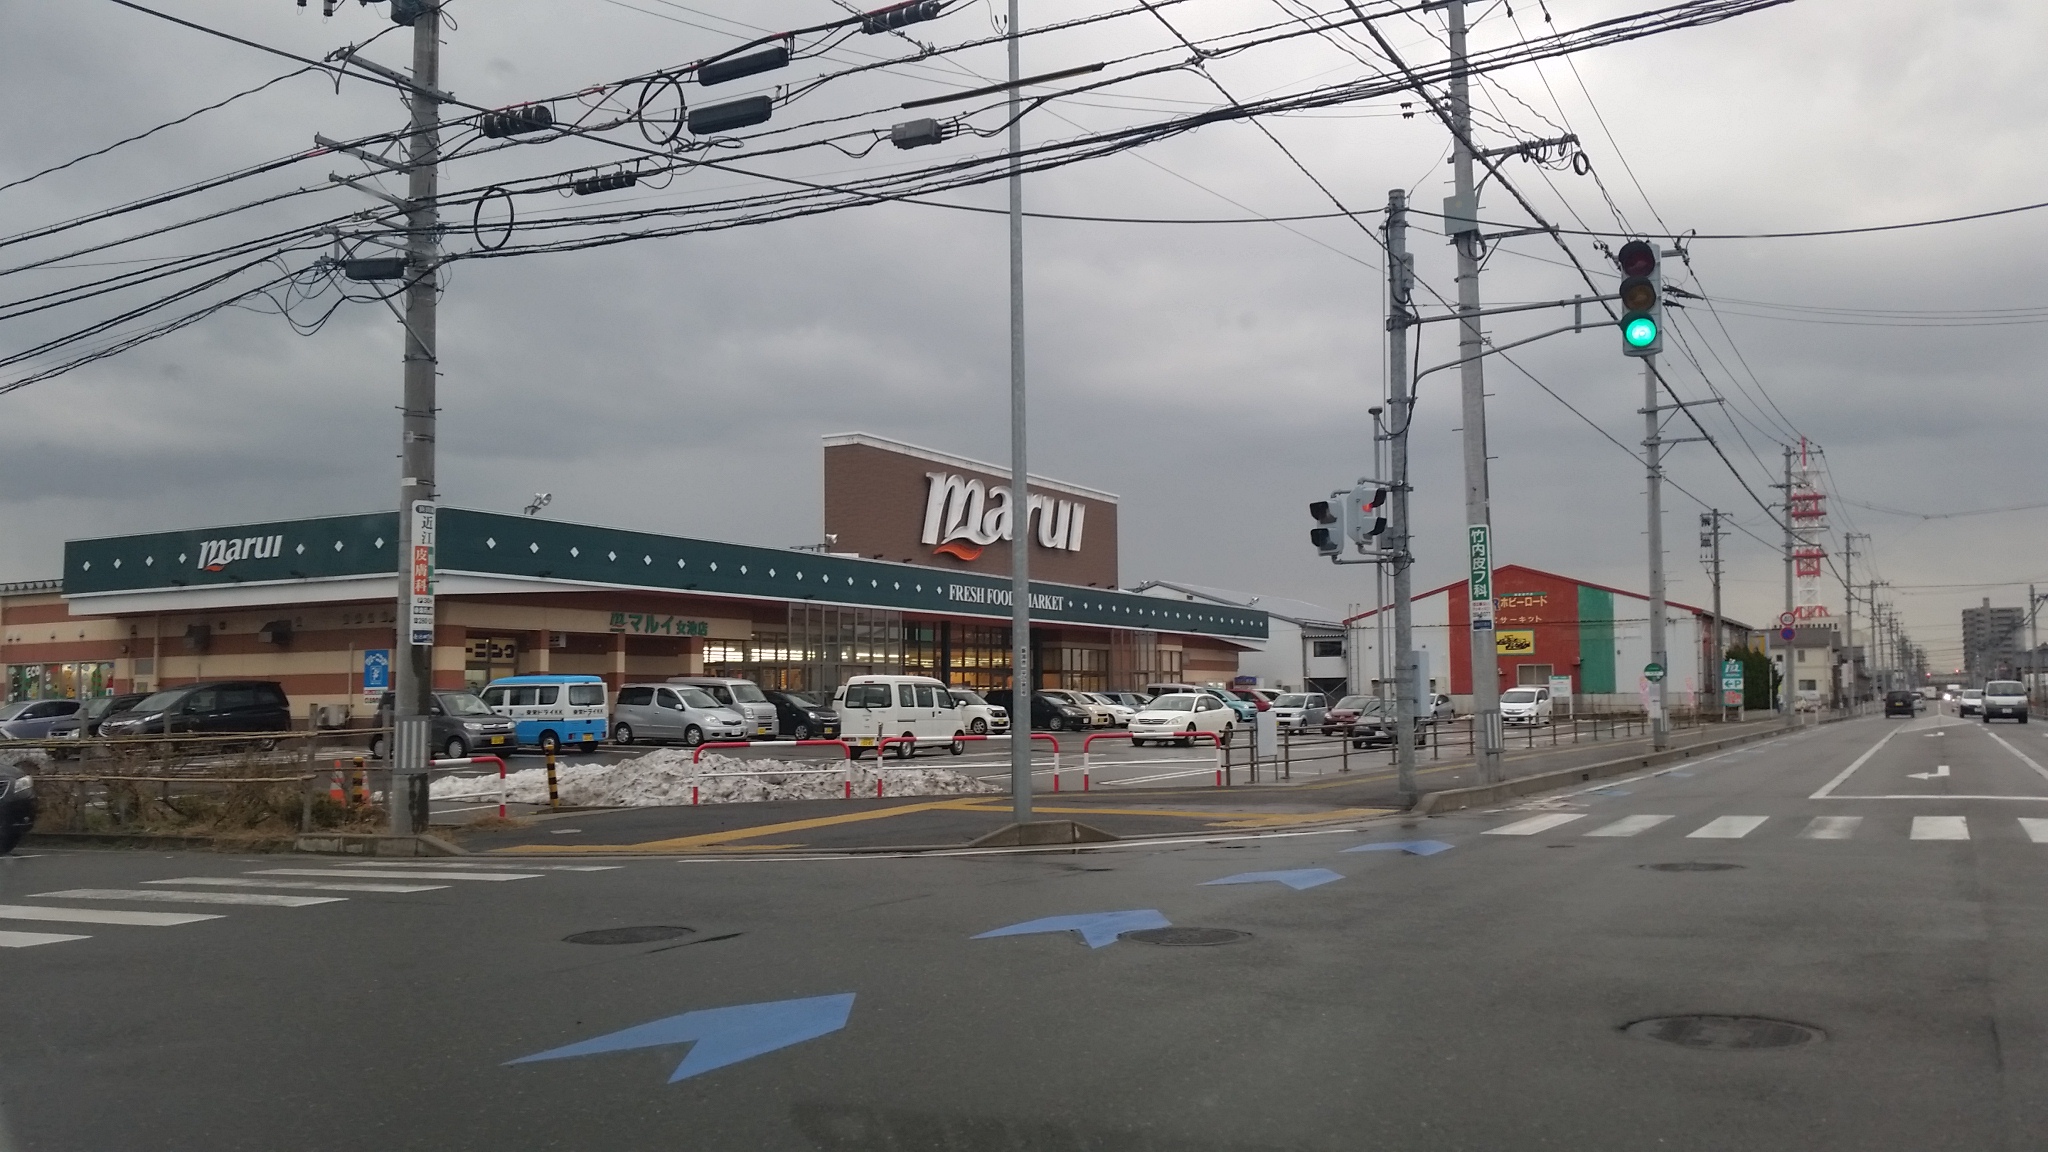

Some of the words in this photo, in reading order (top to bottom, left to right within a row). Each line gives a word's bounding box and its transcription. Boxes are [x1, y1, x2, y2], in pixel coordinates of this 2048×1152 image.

[922, 472, 1086, 551] marui
[197, 534, 283, 570] marui
[1471, 529, 1488, 598] 竹内皮フ科
[949, 584, 985, 604] FRESH
[1500, 596, 1548, 608] ホビーロード
[1495, 615, 1542, 624] サーキット
[26, 665, 40, 678] ECO
[1734, 680, 1742, 688] P
